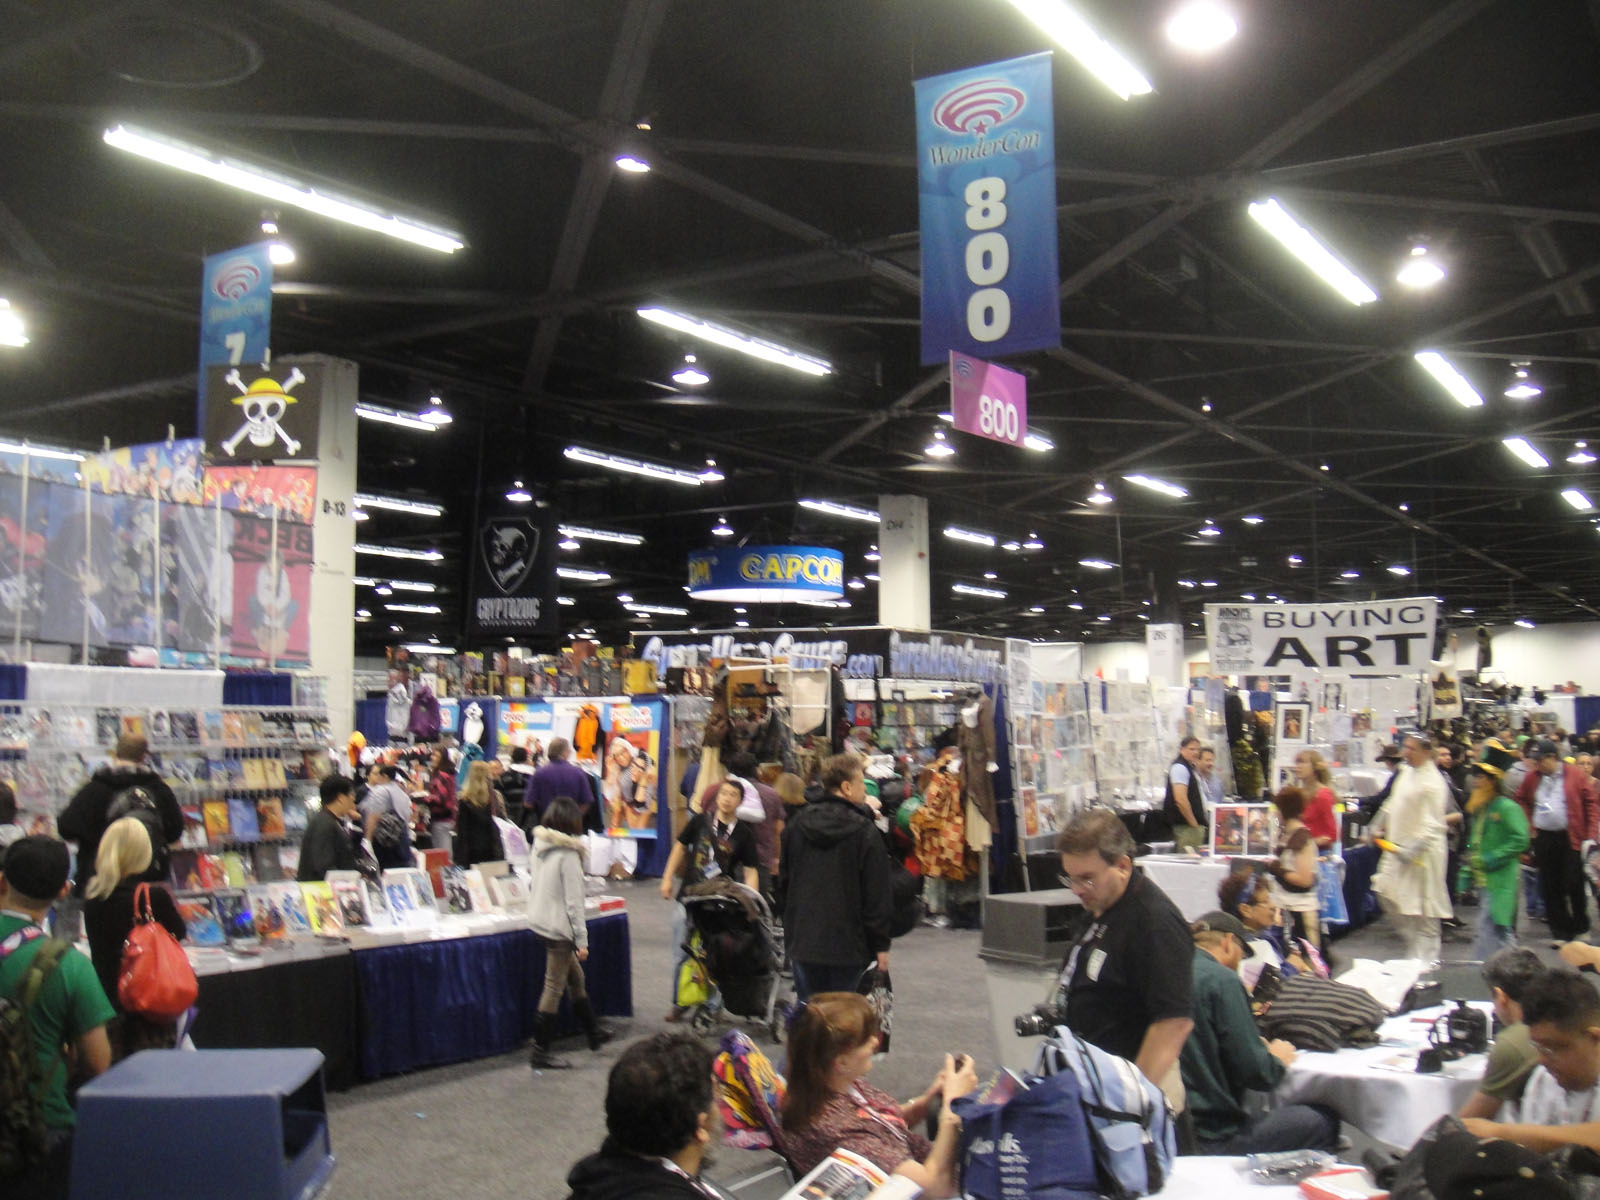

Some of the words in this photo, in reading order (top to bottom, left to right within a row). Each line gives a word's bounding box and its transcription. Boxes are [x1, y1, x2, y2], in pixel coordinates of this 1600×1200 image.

[928, 130, 1041, 168] WonderCon
[964, 176, 1012, 343] 800
[979, 394, 1019, 442] 800
[1263, 606, 1425, 629] BUYING
[1263, 632, 1428, 668] ART
